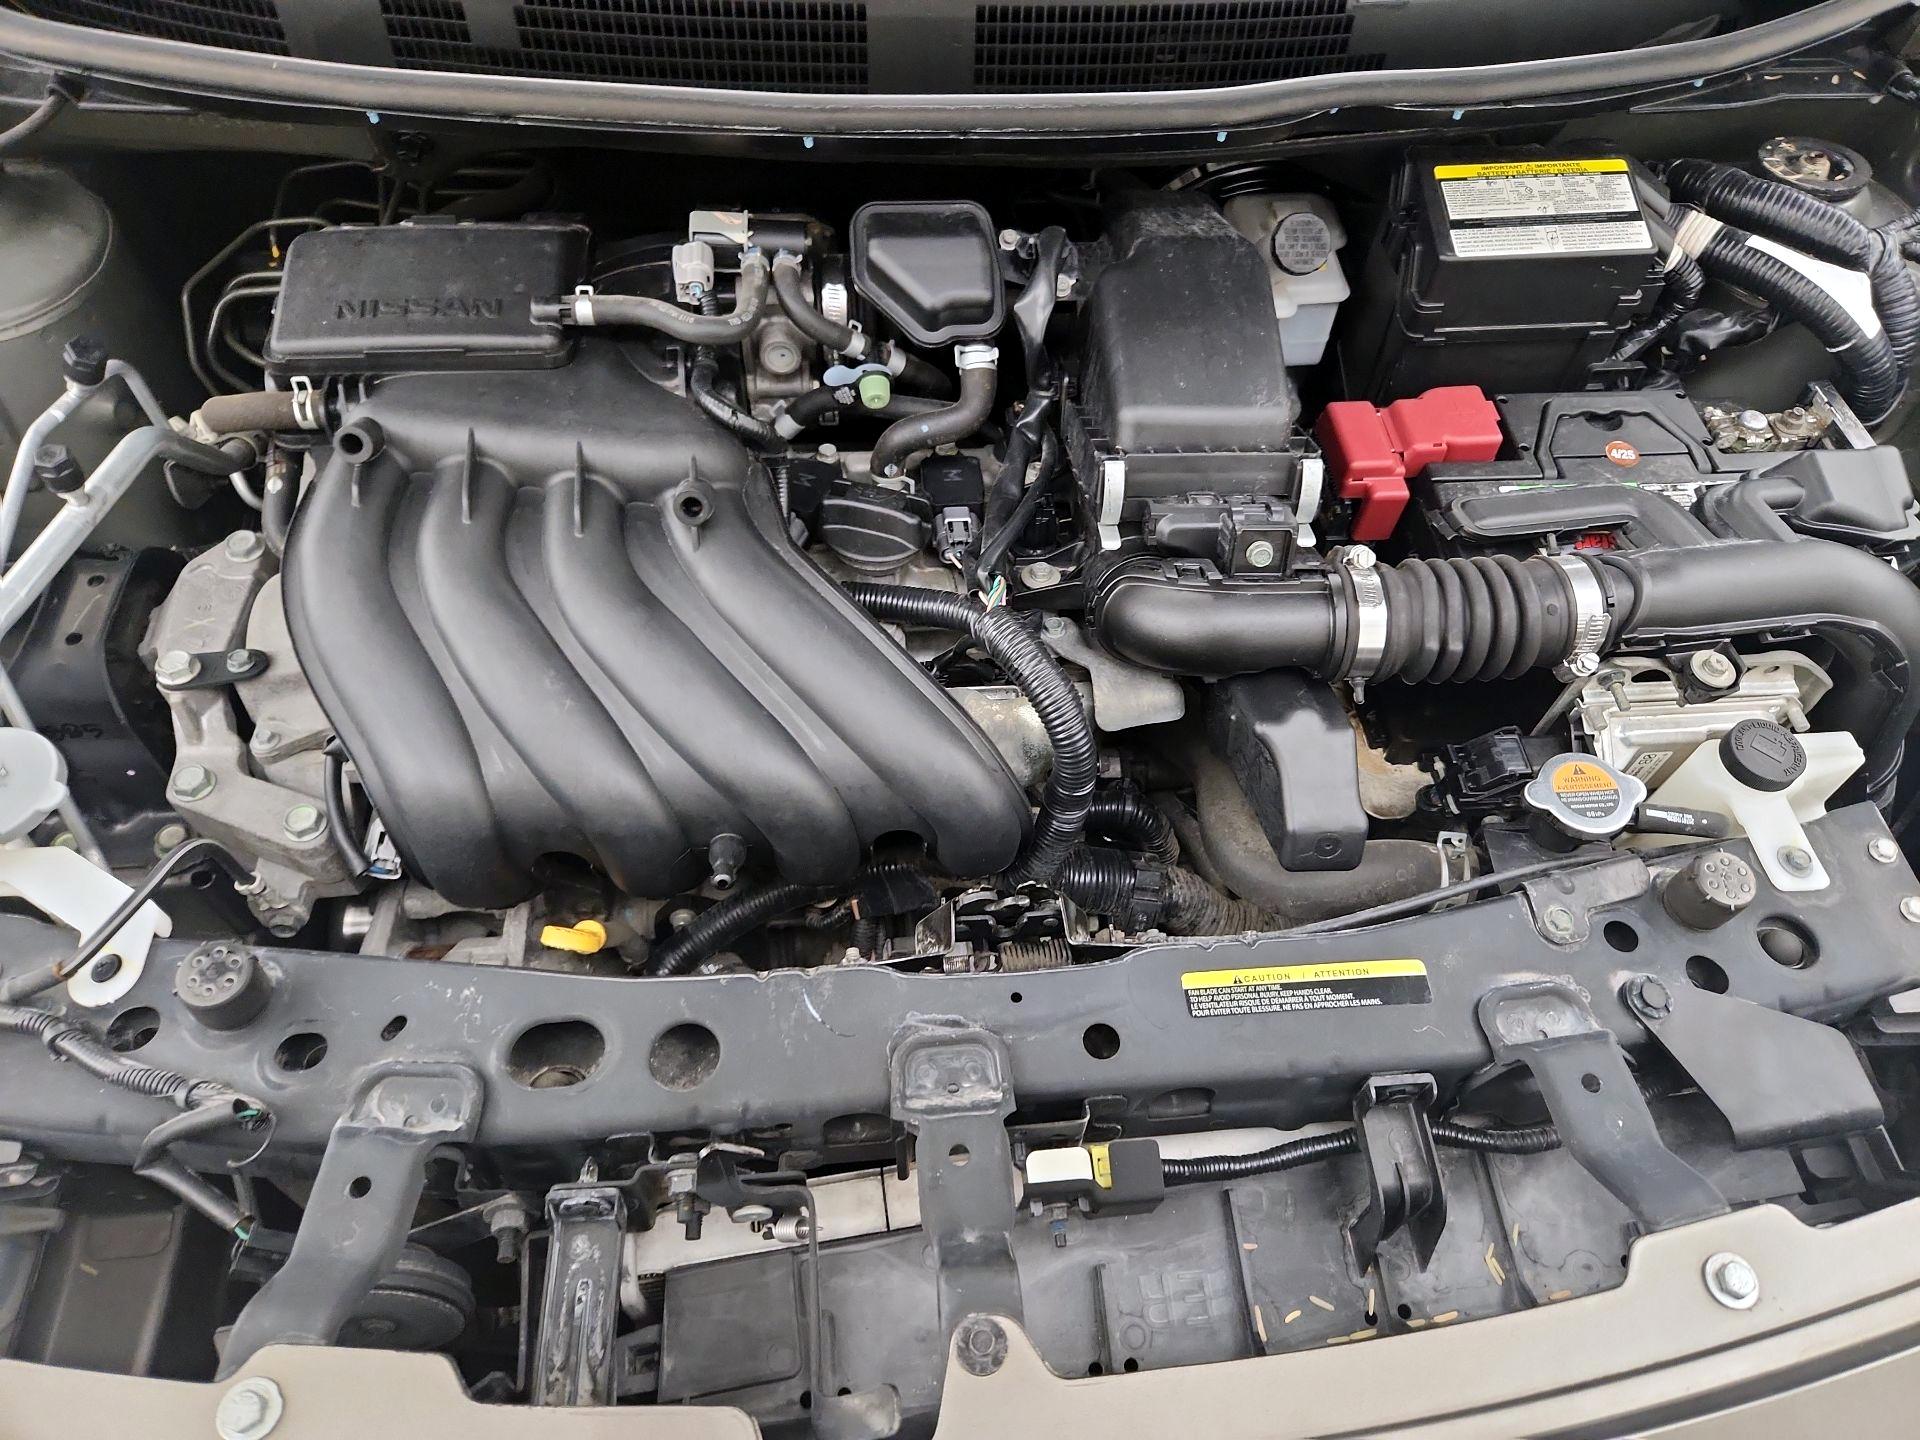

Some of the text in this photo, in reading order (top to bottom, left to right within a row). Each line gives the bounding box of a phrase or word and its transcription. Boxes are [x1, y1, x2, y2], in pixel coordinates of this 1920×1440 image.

[336, 298, 501, 319] NISSAN
[1610, 448, 1636, 460] 4/25
[1563, 775, 1601, 783] WARNING
[1557, 782, 1612, 790] AVERTISSEMENT
[1244, 973, 1291, 983] CAUTION
[1314, 968, 1370, 978] ATTENTION
[1200, 988, 1218, 996] BLADE
[1231, 992, 1259, 1000] PERSONAL
[1280, 989, 1293, 997] KEEP
[1294, 988, 1313, 996] HANDS
[1314, 987, 1333, 995] CLEAR.
[1191, 1002, 1199, 1010] LE
[1199, 1000, 1238, 1009] VENTILATEUR
[1326, 992, 1355, 1001] MOMENT.
[1192, 1009, 1210, 1017] POUR
[1231, 1006, 1251, 1014] TOUTE
[1282, 1003, 1291, 1011] NE
[1292, 1002, 1303, 1010] PAS
[1304, 1001, 1313, 1009] EN
[1314, 999, 1349, 1008] APPROCHER
[1361, 997, 1382, 1006] MAINS.
